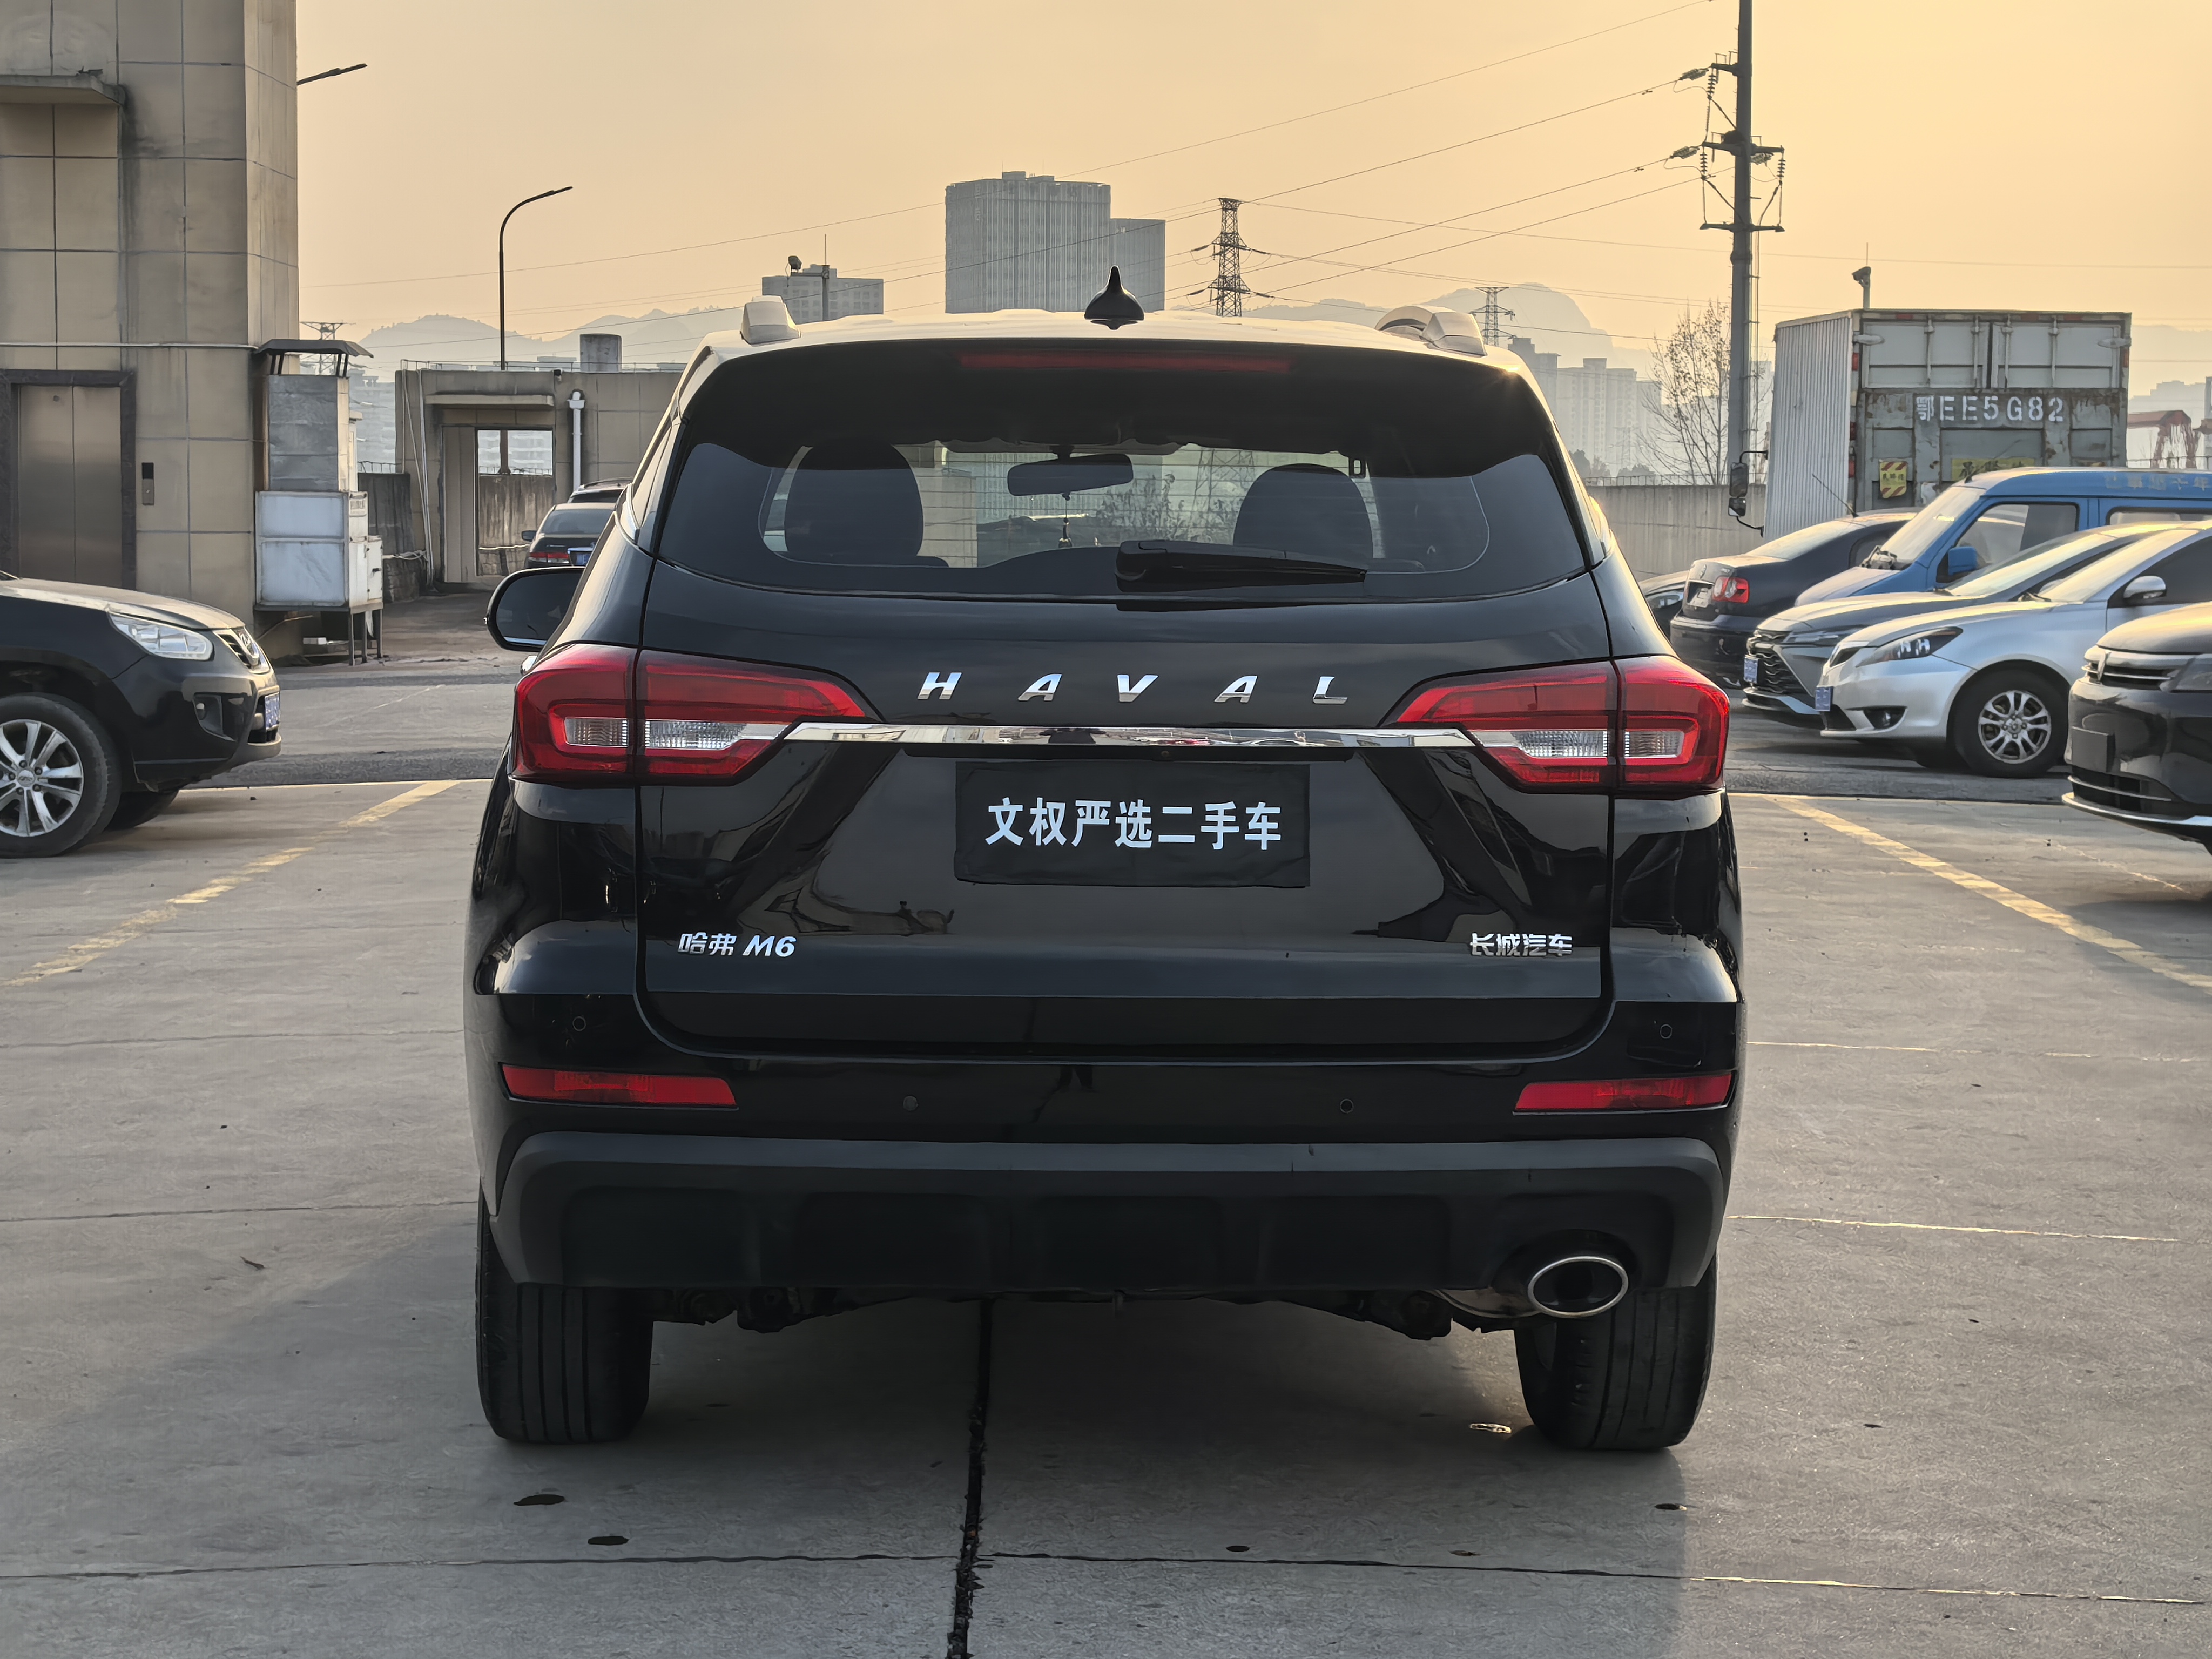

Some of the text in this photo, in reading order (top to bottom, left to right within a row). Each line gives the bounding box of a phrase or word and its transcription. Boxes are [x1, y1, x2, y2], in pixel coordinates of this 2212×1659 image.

[1916, 395, 2063, 422] 鄂EE5G82
[916, 672, 1348, 704] HAVAL
[985, 797, 1282, 850] 文权严选二手车
[678, 932, 797, 957] 哈弗 M6
[1469, 932, 1573, 957] 长城汽车
